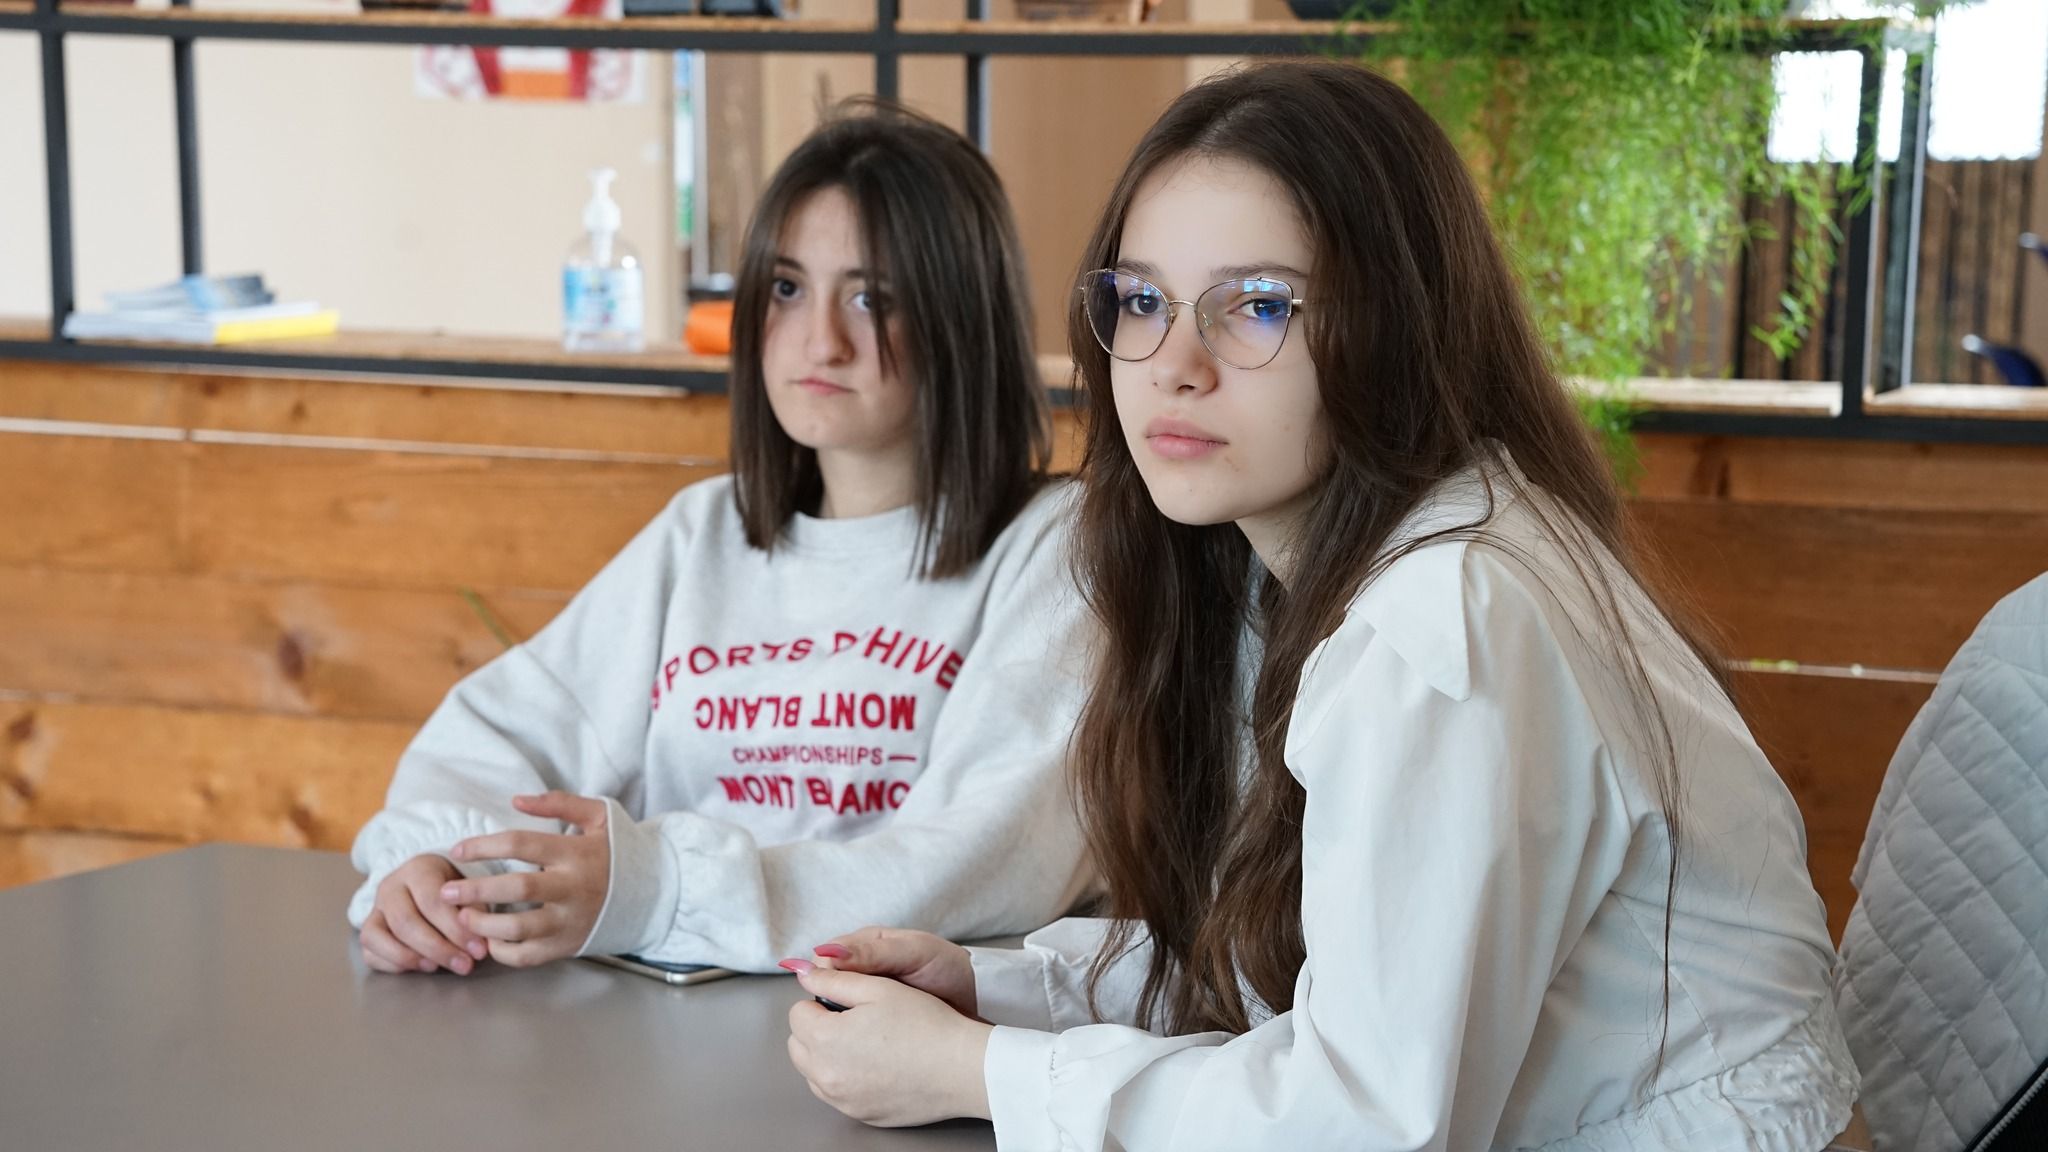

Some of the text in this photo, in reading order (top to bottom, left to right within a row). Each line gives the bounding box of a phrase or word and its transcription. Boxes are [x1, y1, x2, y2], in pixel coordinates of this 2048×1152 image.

[694, 691, 917, 732] MONT BLANC
[733, 746, 883, 766] CHAMPIONSHIPS
[717, 774, 912, 816] MONT BANC
